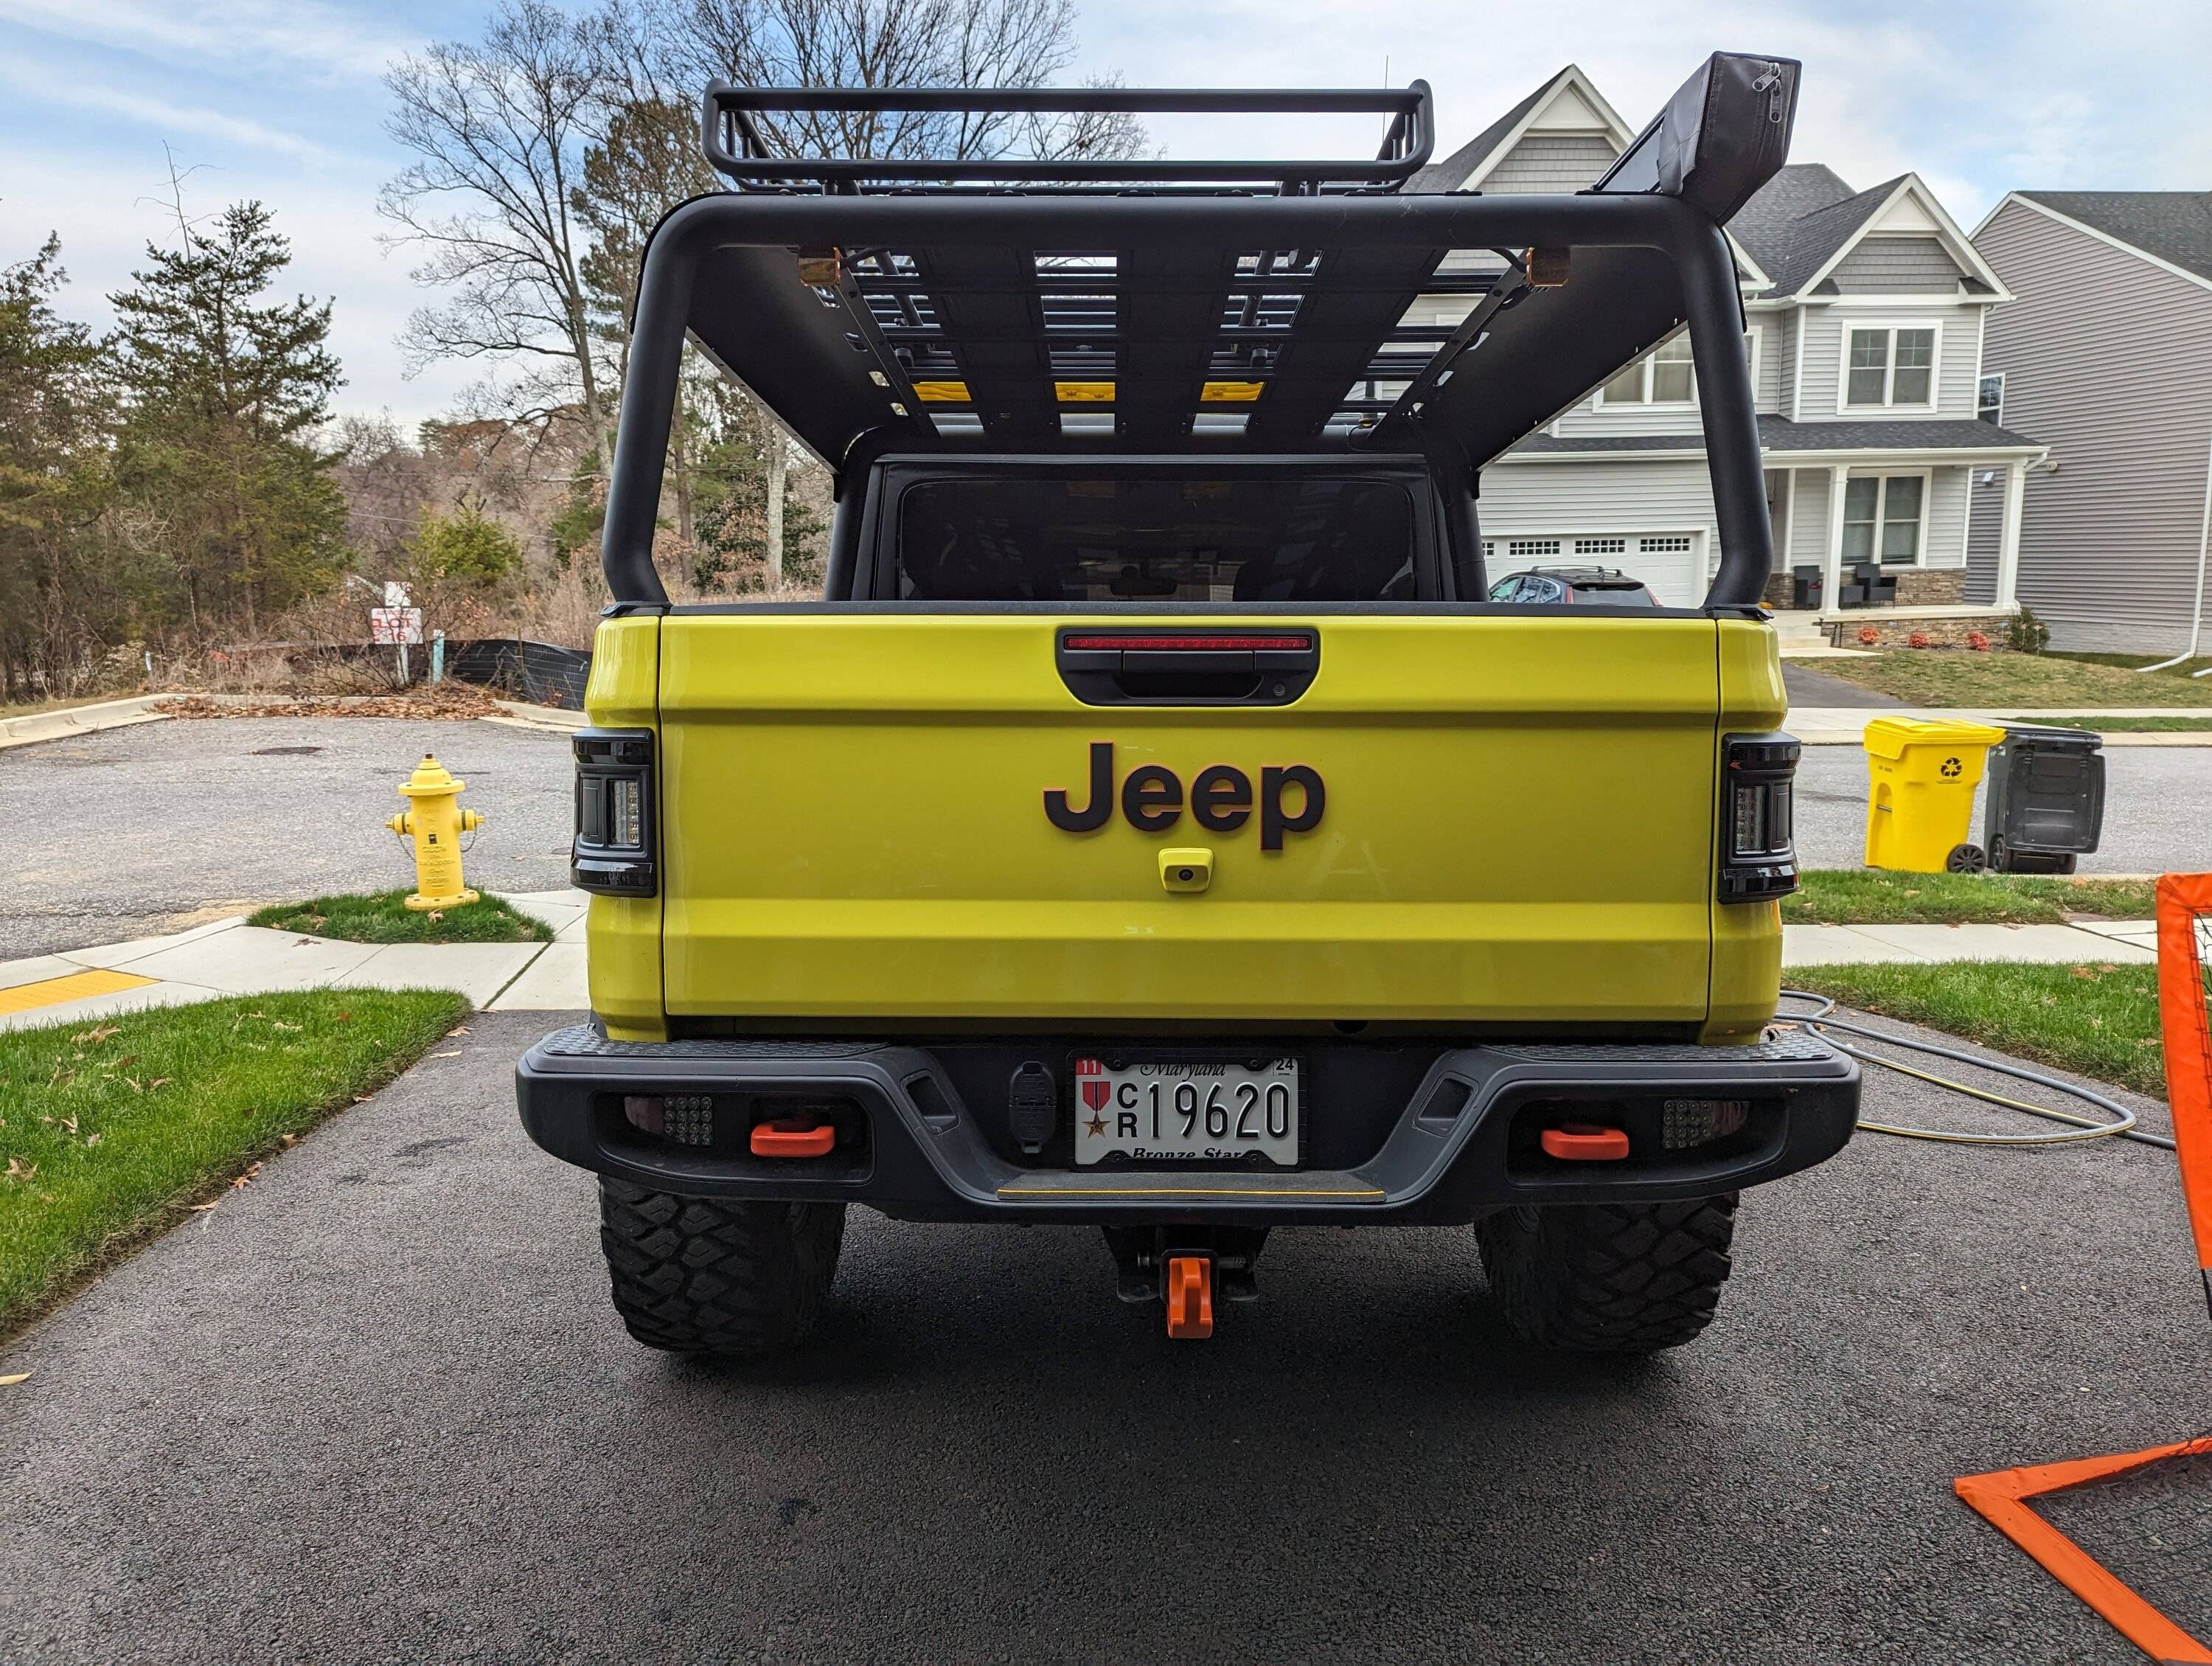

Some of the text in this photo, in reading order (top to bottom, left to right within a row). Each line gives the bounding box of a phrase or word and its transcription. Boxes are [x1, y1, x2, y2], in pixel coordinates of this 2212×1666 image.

[1043, 740, 1326, 850] Jeep
[1082, 1059, 1097, 1074] 11
[1140, 1063, 1225, 1082] Maryland
[1276, 1058, 1294, 1071] 24
[1148, 1082, 1290, 1138] 19620
[1132, 1148, 1242, 1158] Bronze Star
